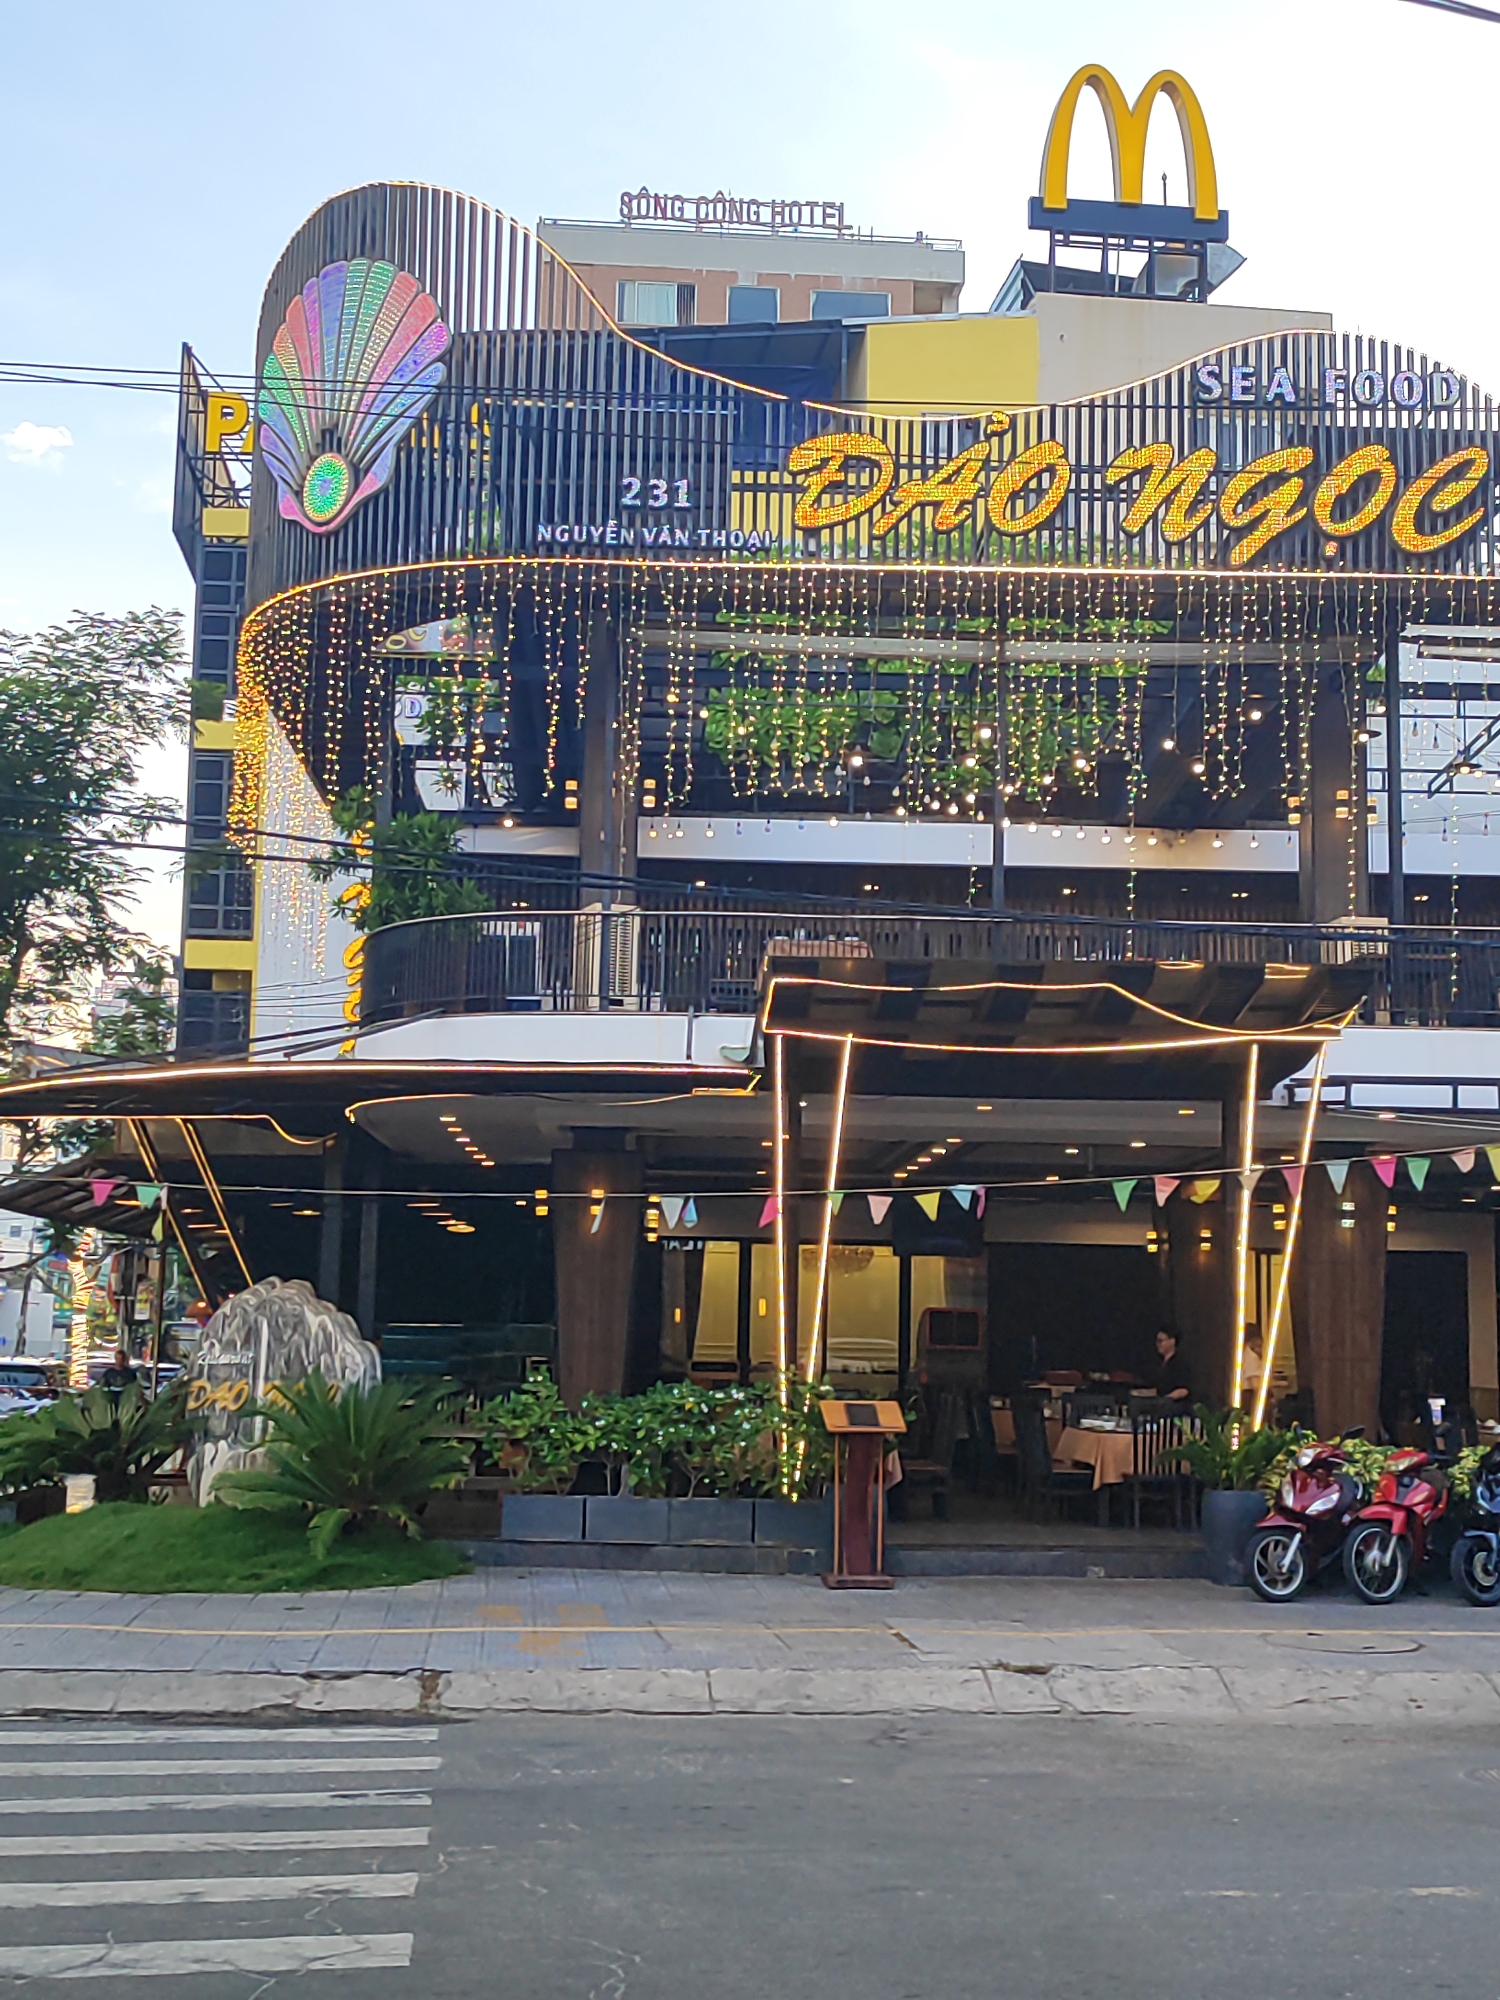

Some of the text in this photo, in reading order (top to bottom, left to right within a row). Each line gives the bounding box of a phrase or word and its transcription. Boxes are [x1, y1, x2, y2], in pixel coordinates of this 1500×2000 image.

[620, 186, 685, 221] SÔNG
[771, 199, 853, 230] HOTEL
[1197, 363, 1460, 407] SEA FOOD
[620, 477, 692, 508] 231
